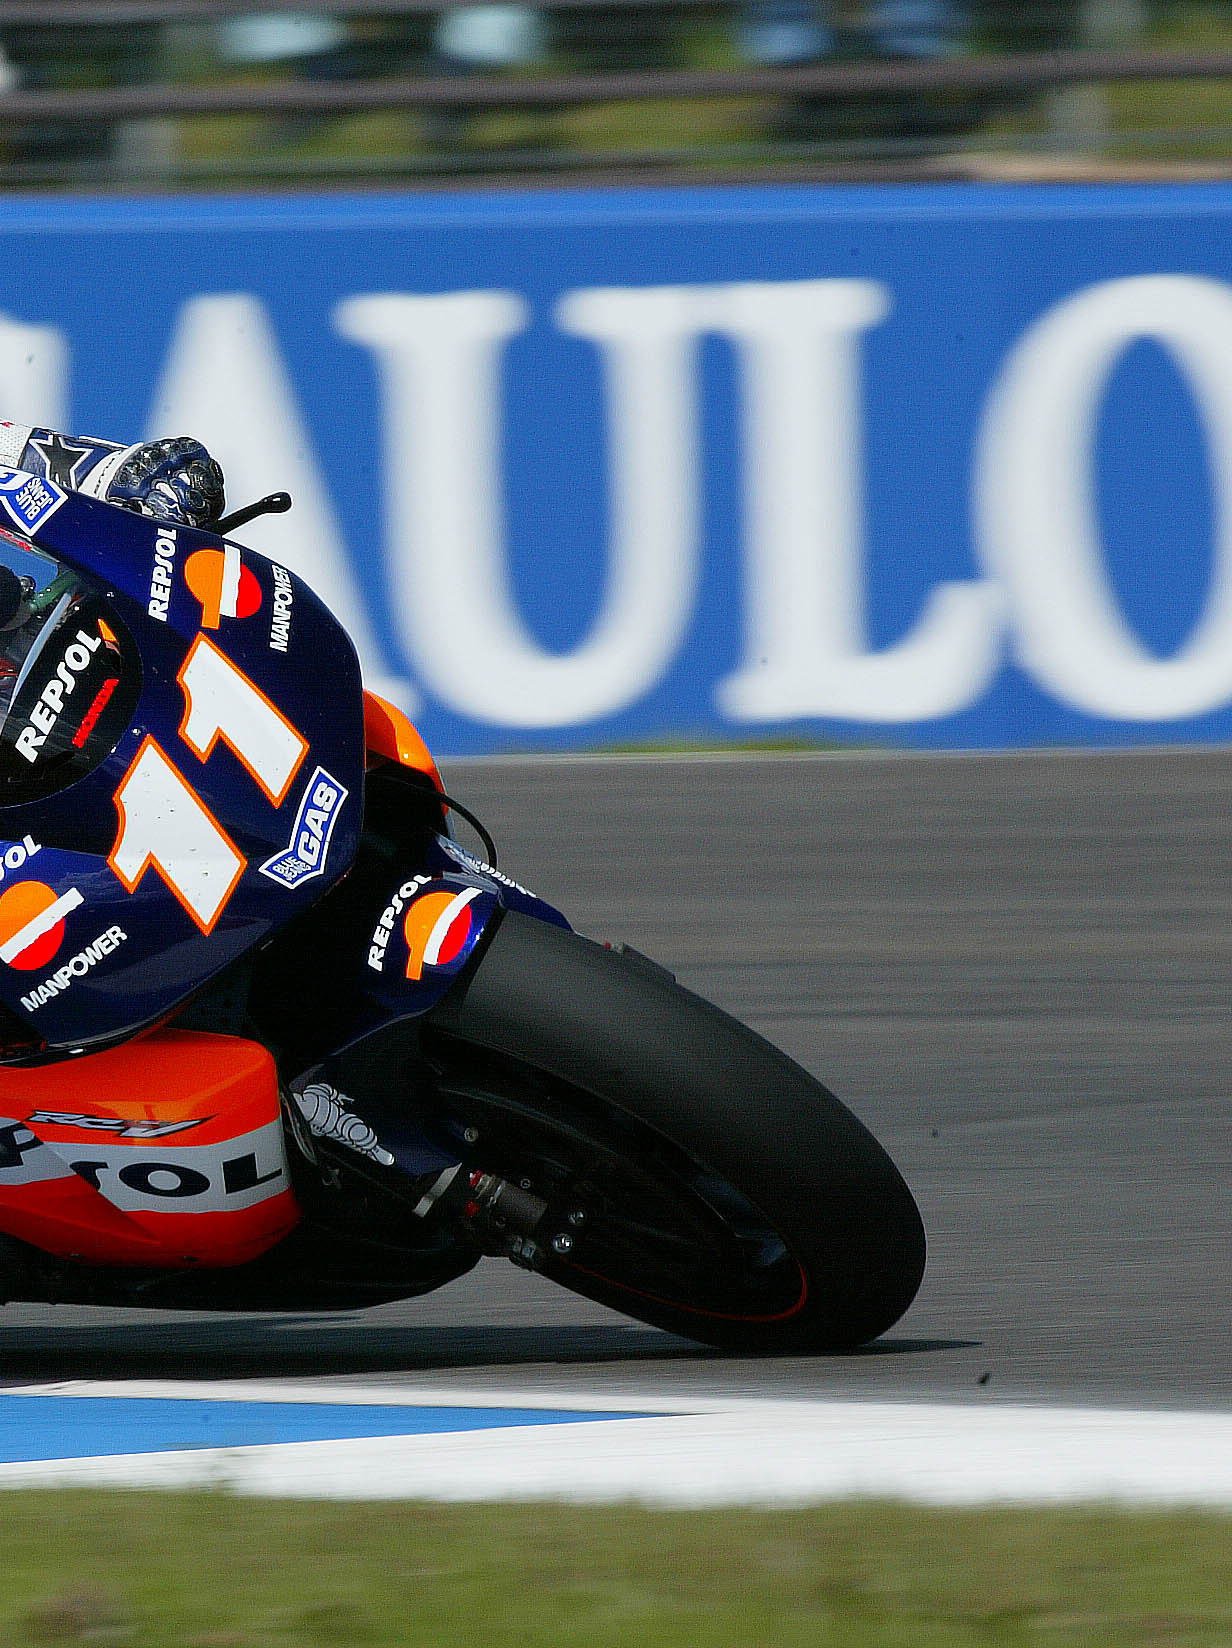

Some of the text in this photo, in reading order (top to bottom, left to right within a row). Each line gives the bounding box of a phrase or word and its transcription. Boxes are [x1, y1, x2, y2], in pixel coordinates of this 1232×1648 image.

[15, 485, 43, 521] BLUE
[27, 477, 55, 510] JEANS
[148, 528, 177, 622] REPSOL
[269, 564, 293, 653] MANPOWER
[14, 630, 102, 764] REPSOL
[107, 631, 310, 937] 11
[297, 781, 338, 866] GAS
[367, 874, 432, 972] REPSOL
[20, 925, 128, 1012] MANPOWER
